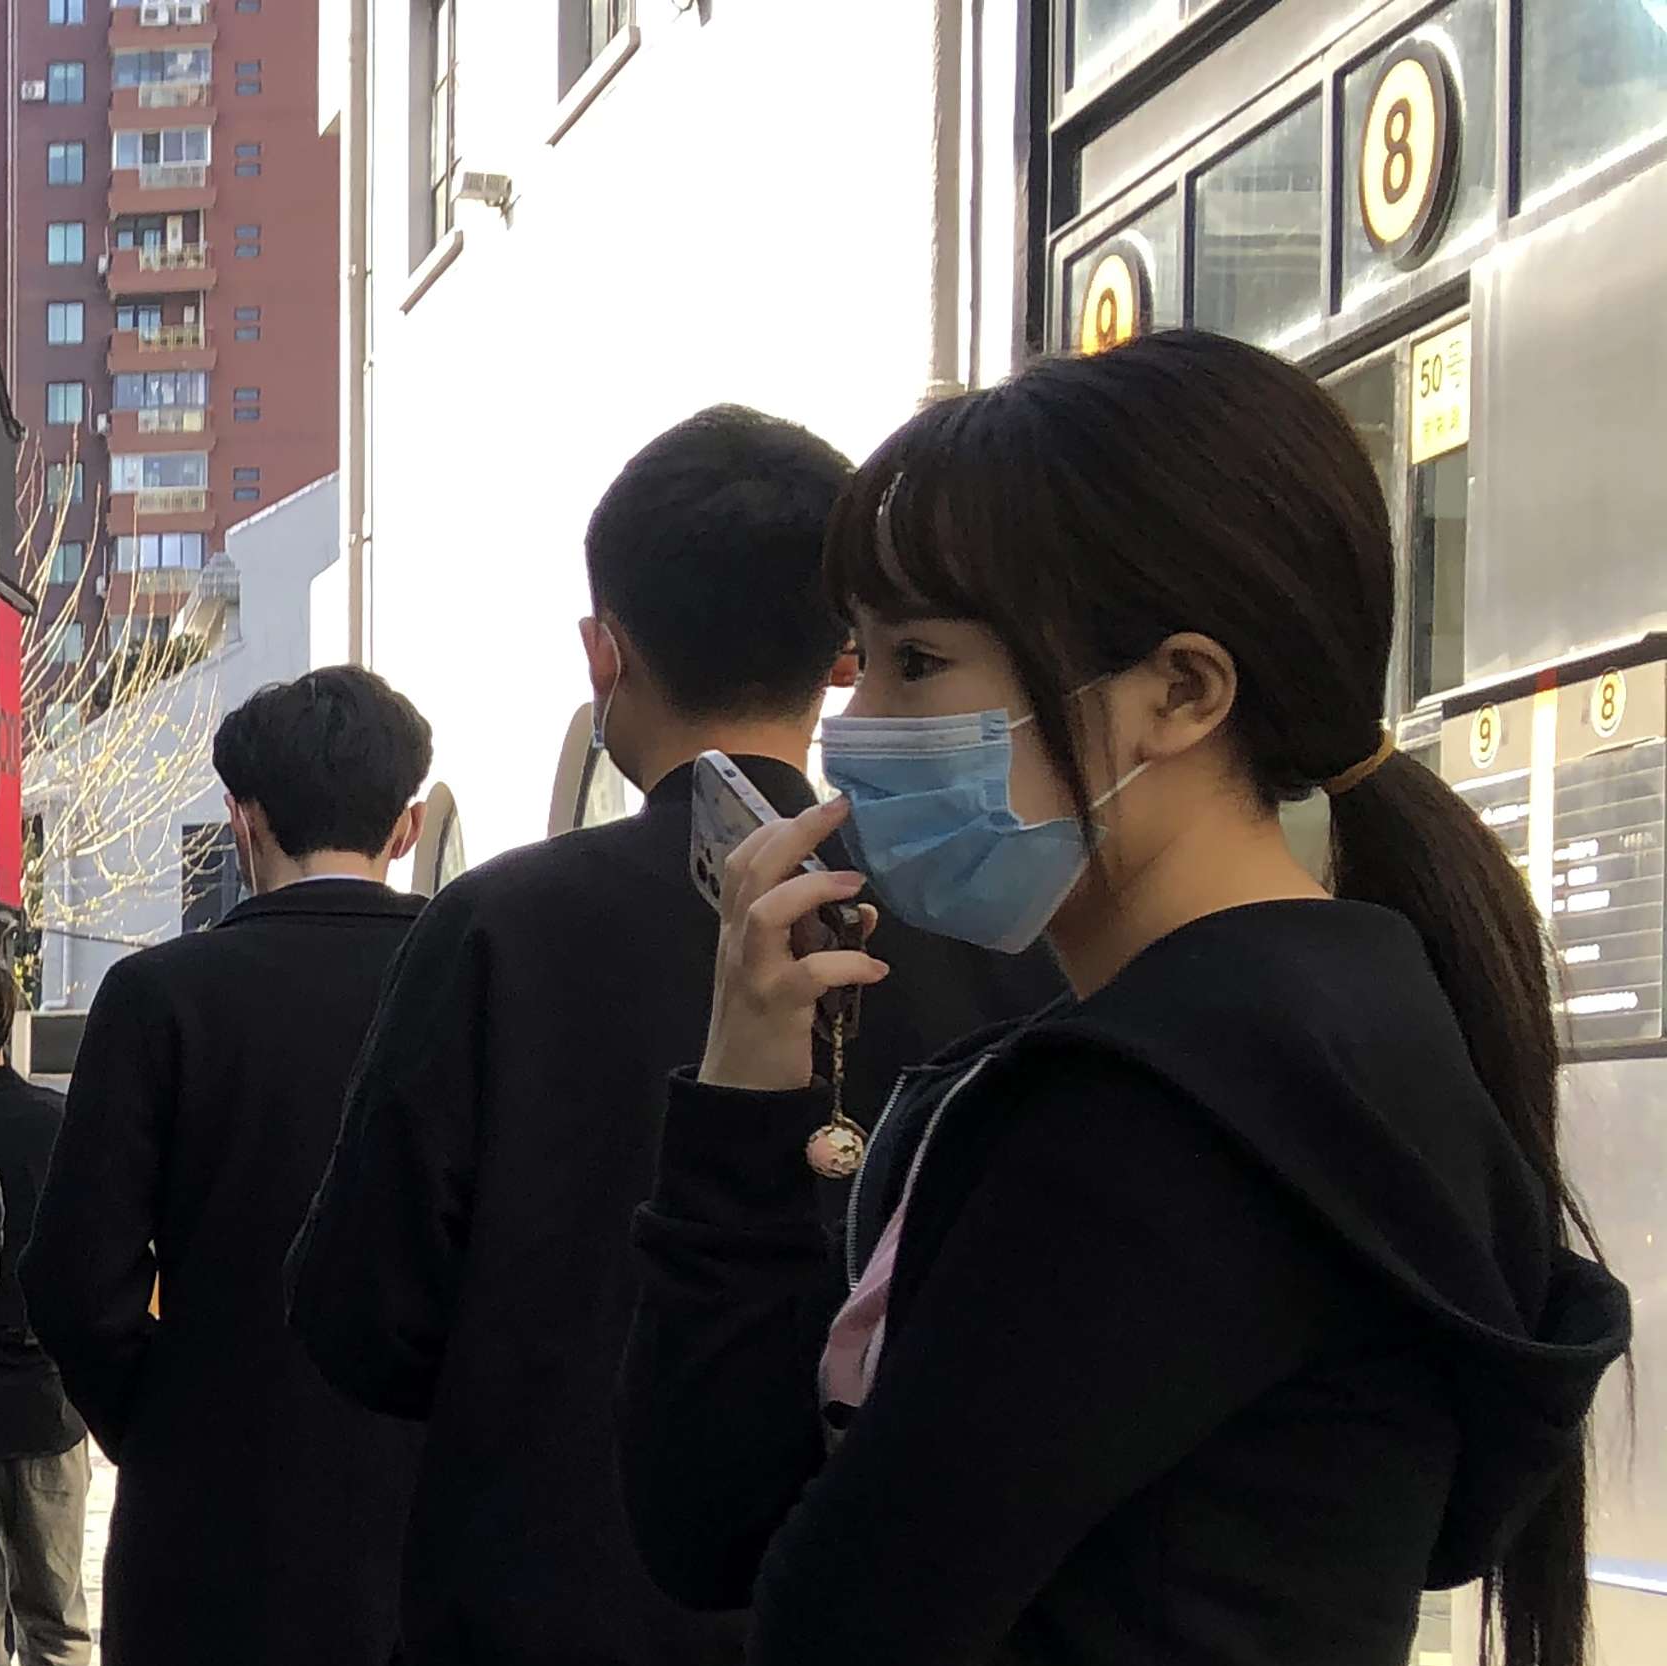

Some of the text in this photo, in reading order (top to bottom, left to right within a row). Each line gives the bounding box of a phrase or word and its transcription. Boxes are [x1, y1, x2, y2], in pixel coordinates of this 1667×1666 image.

[1382, 97, 1414, 205] 8
[1601, 683, 1615, 721] 8
[1479, 717, 1492, 753] 9
